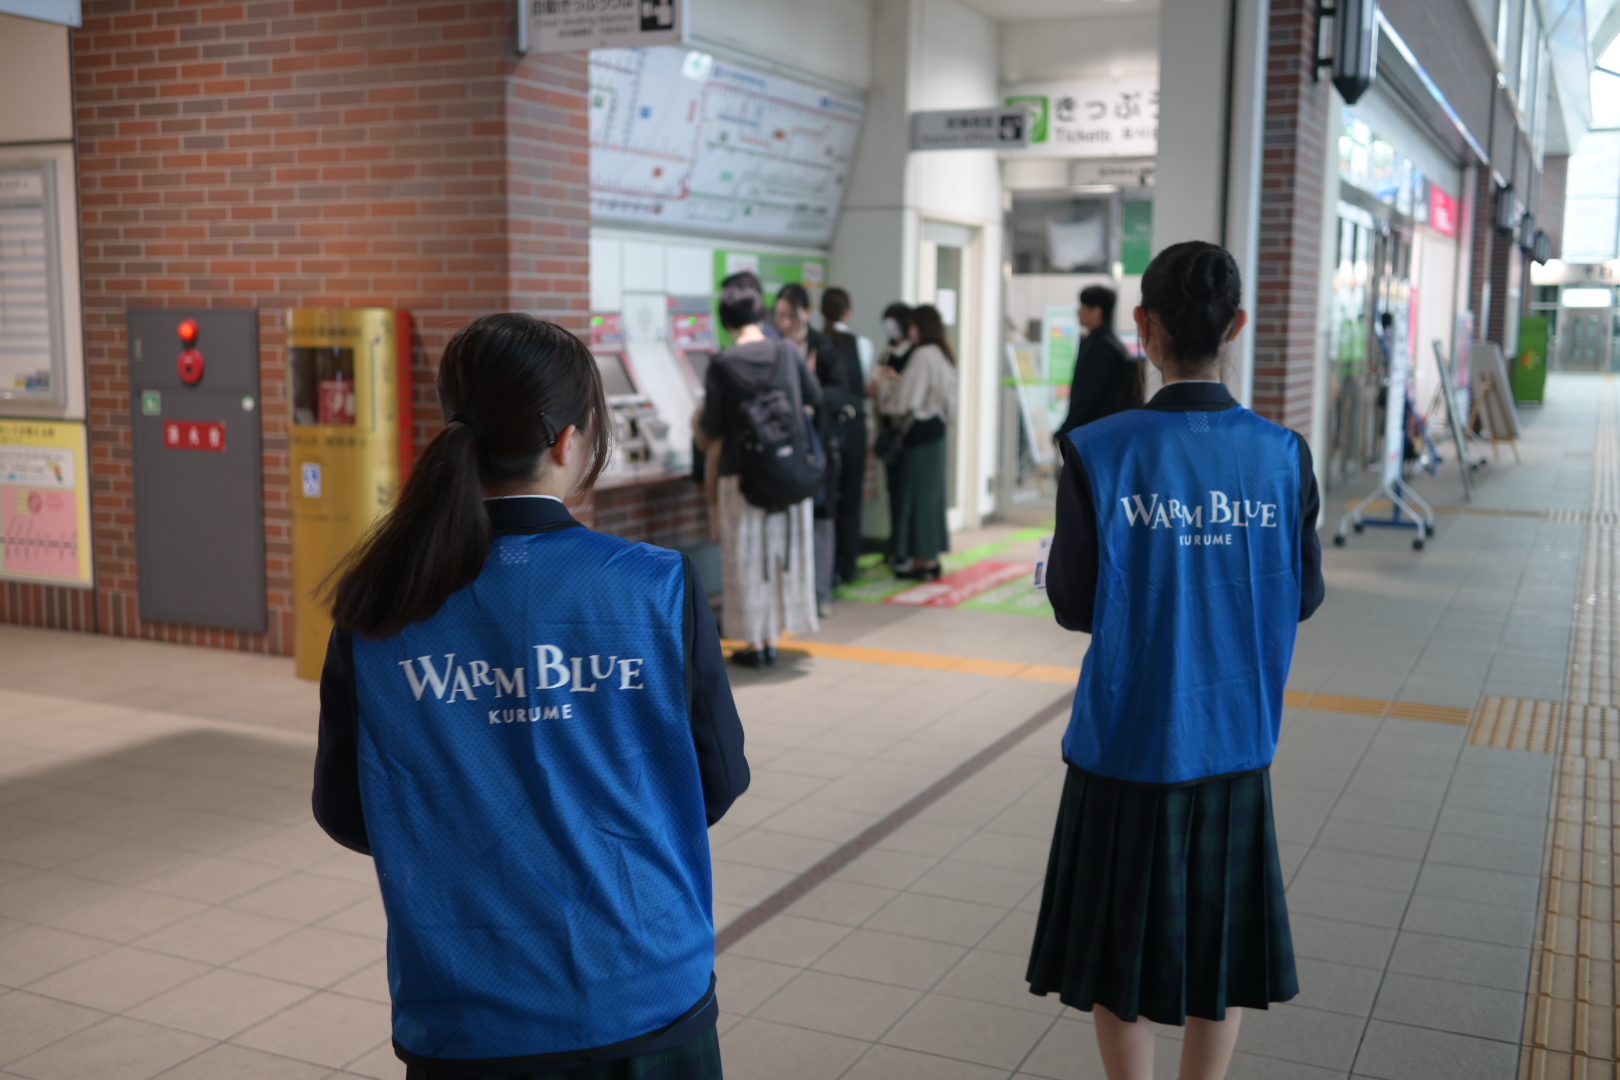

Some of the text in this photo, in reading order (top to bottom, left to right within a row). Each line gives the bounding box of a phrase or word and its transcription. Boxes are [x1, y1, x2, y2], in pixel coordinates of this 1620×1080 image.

[1120, 490, 1277, 530] WARM BLUE
[1179, 533, 1232, 546] KURUME
[398, 644, 645, 704] WARM BLUE
[488, 703, 573, 725] KURUME
